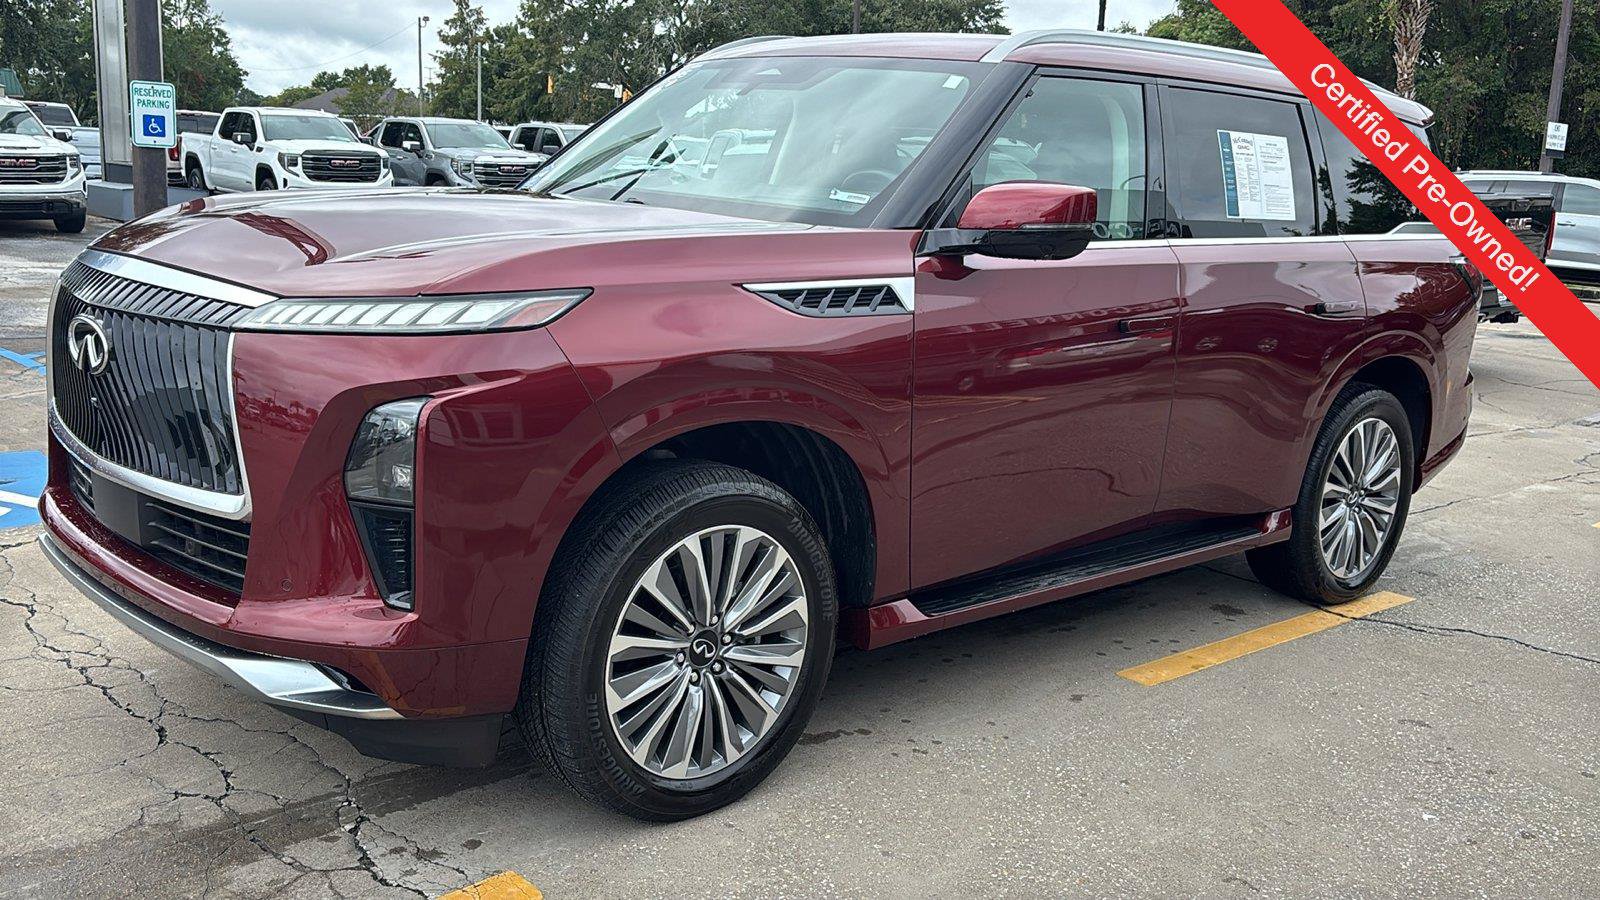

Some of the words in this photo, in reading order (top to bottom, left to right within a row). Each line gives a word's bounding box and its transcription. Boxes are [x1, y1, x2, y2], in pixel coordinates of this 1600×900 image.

[134, 87, 171, 98] RESERVED
[137, 99, 170, 109] PARKING
[1505, 217, 1532, 230] GMC
[786, 516, 833, 621] BRIDGESTONE
[585, 693, 649, 797] BRIDGESTONE
